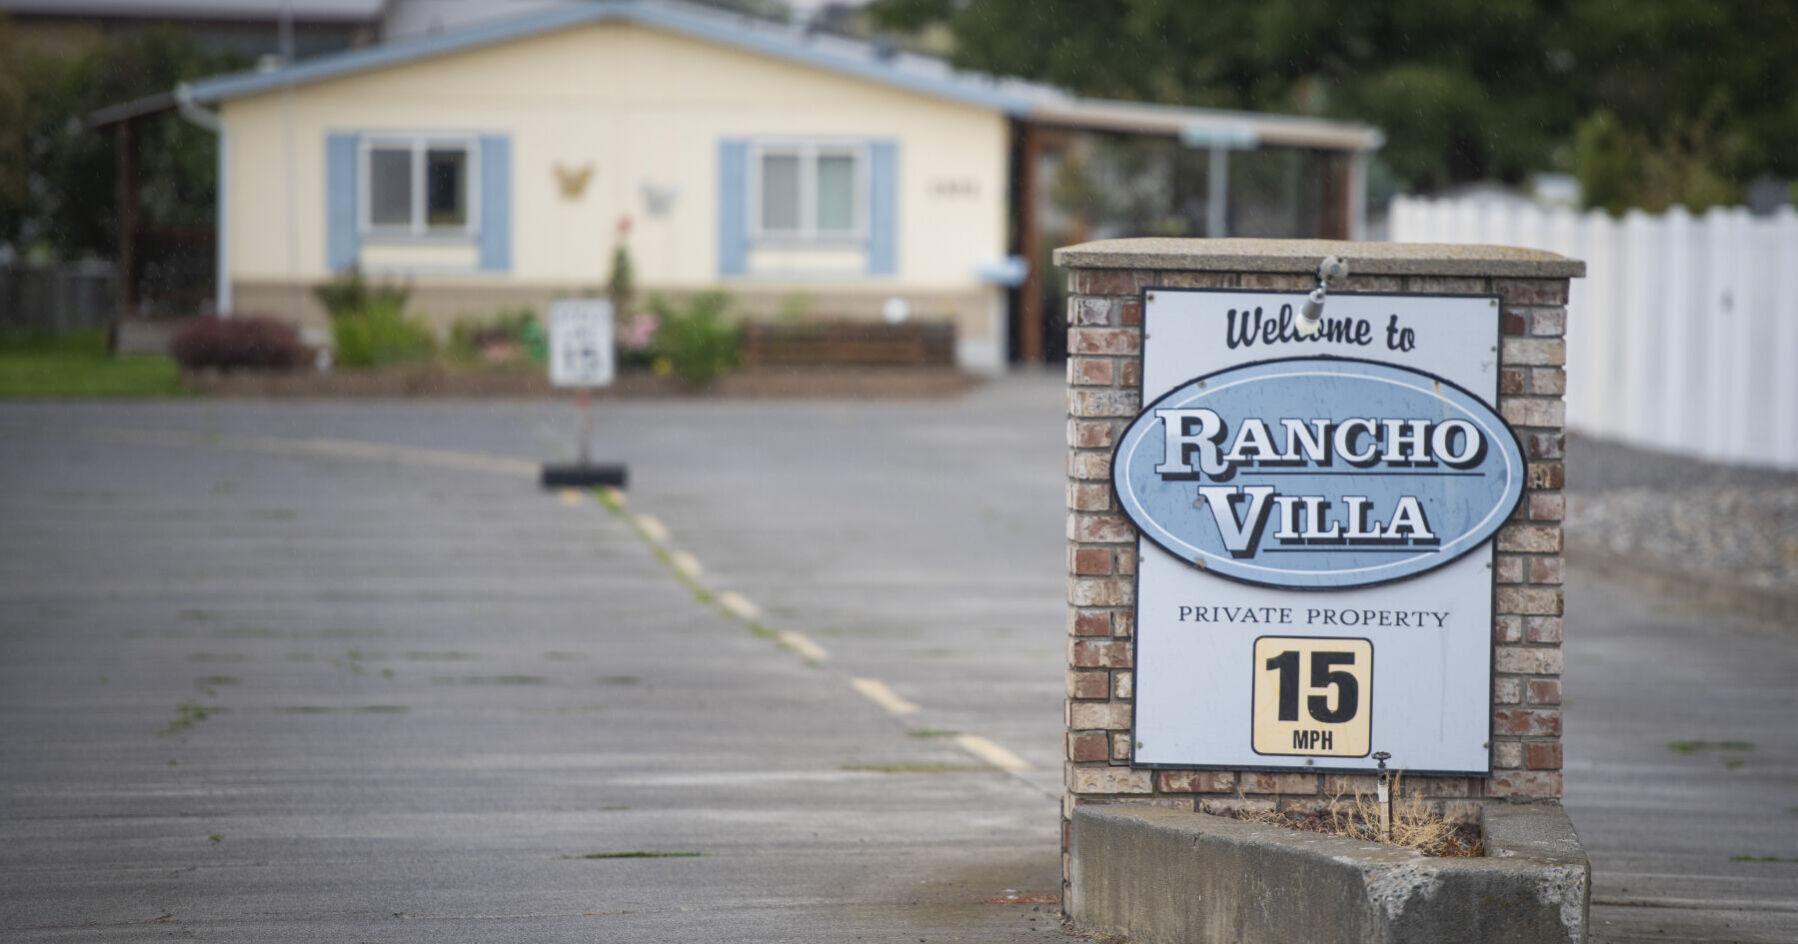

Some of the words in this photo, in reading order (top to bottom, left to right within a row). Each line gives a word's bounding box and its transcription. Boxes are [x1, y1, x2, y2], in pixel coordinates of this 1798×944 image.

[1386, 314, 1416, 353] to
[1154, 407, 1486, 480] RANCHO
[1198, 485, 1439, 557] VILLA
[1178, 605, 1293, 625] PRIVATE
[1306, 608, 1451, 628] PROPERTY
[1265, 650, 1360, 724] 15
[1292, 729, 1334, 751] MPH
